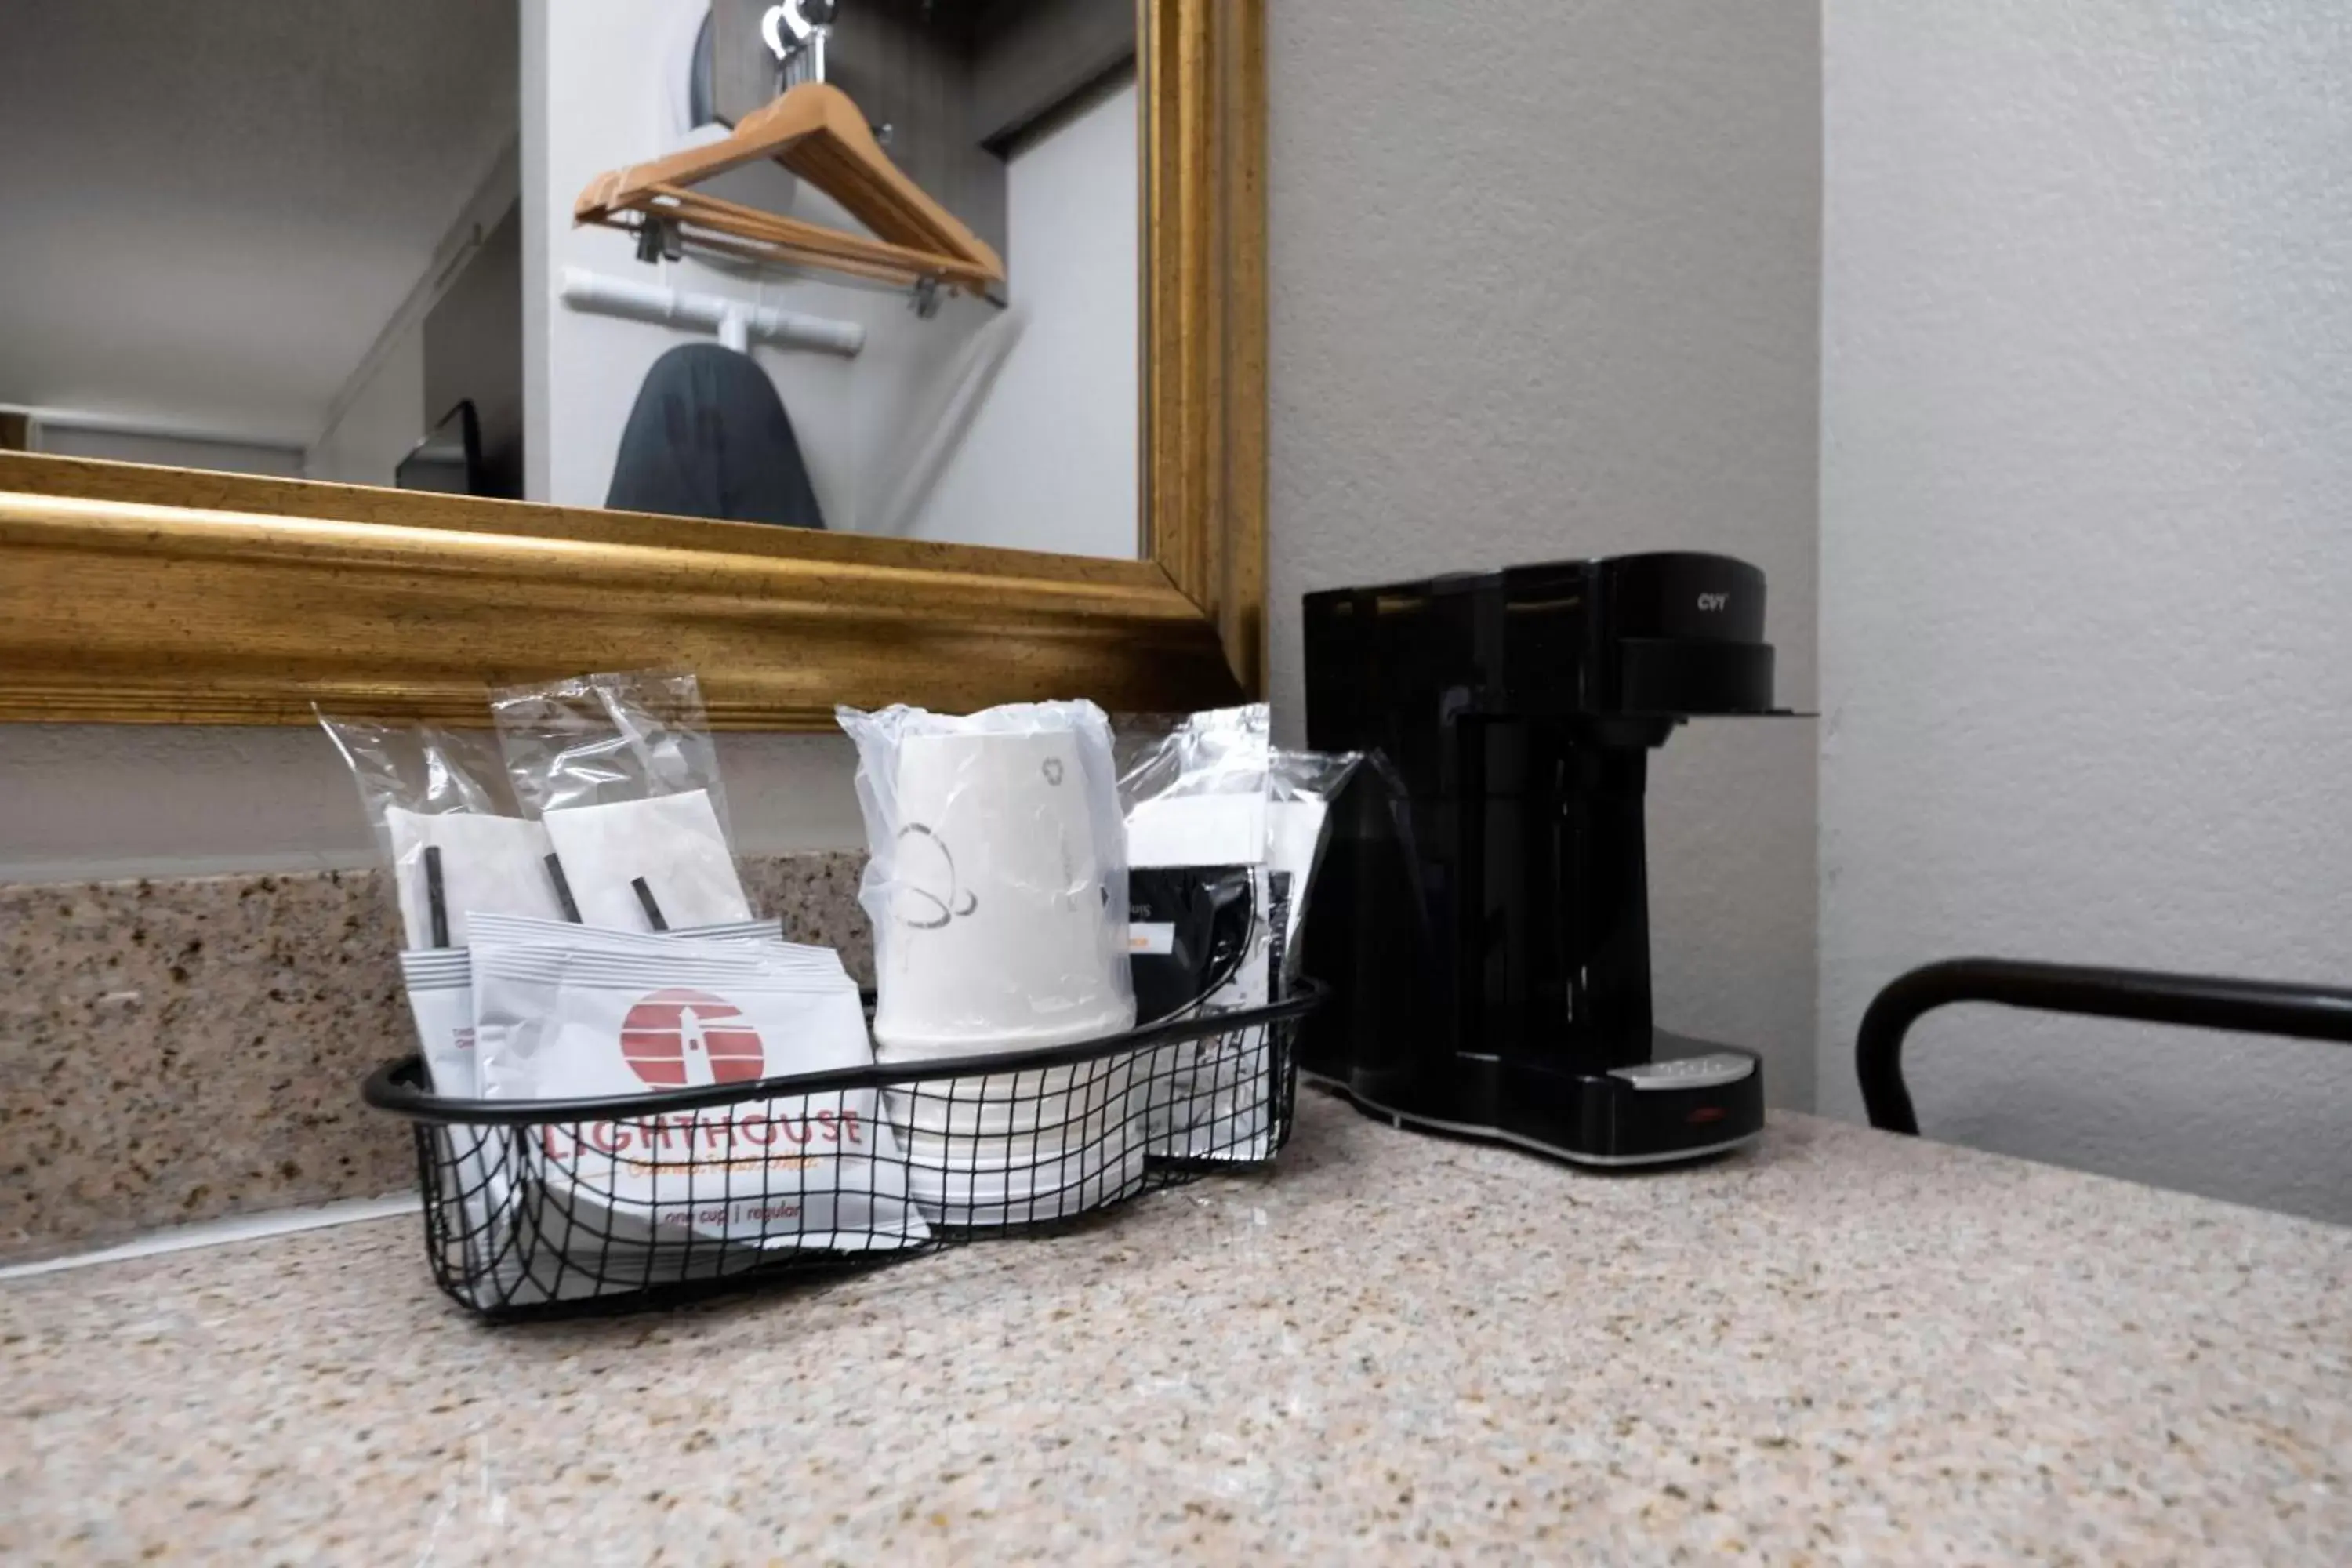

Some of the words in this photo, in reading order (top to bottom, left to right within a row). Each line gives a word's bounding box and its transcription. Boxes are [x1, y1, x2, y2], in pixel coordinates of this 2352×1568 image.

[543, 1110, 862, 1161] LIGHTHOUSE
[699, 1209, 728, 1227] cup
[747, 1200, 801, 1222] regular
